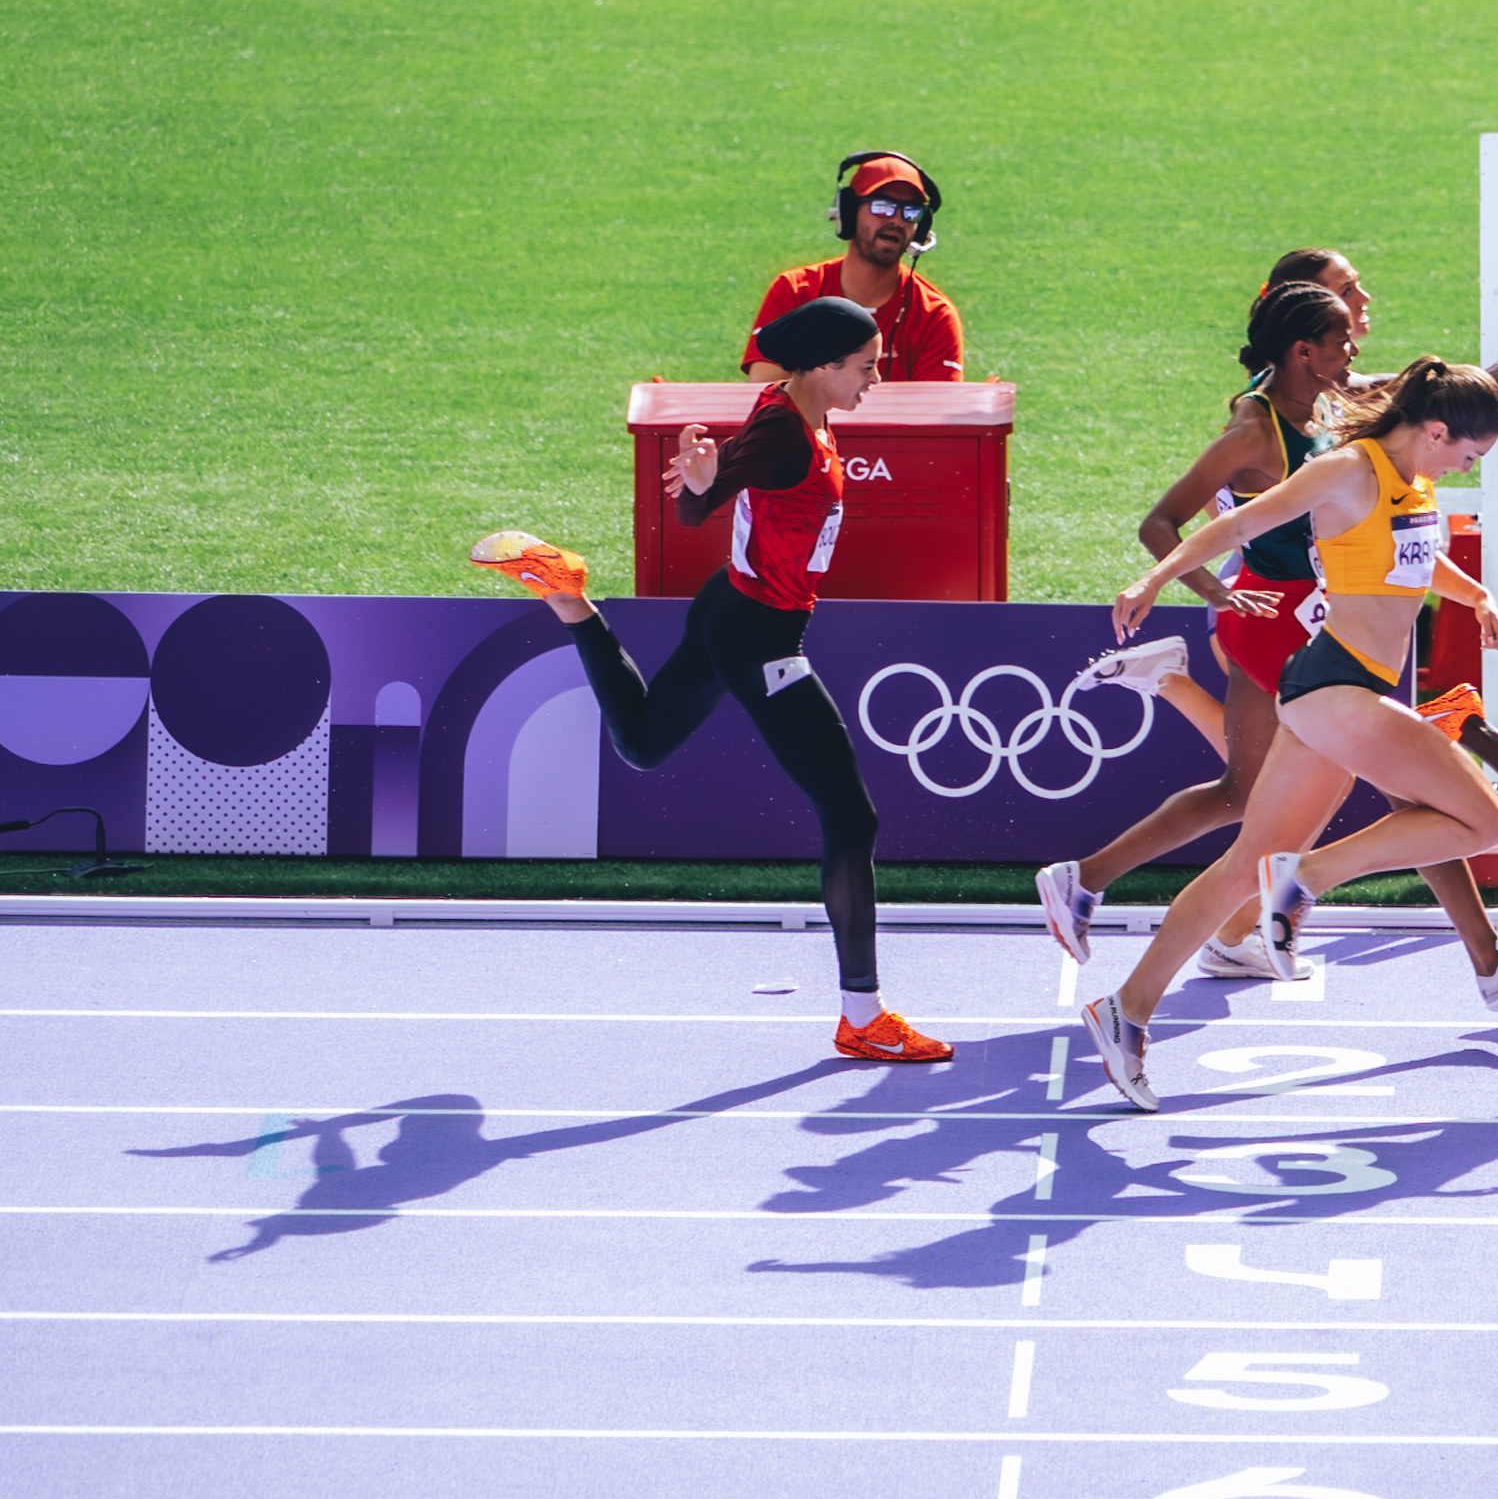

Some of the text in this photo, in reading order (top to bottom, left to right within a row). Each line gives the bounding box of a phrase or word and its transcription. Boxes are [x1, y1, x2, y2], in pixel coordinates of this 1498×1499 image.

[1110, 1006, 1121, 1044] RUNNING
[1195, 1045, 1396, 1097] 2
[1173, 1142, 1398, 1196] 3
[1166, 1352, 1390, 1412] 5
